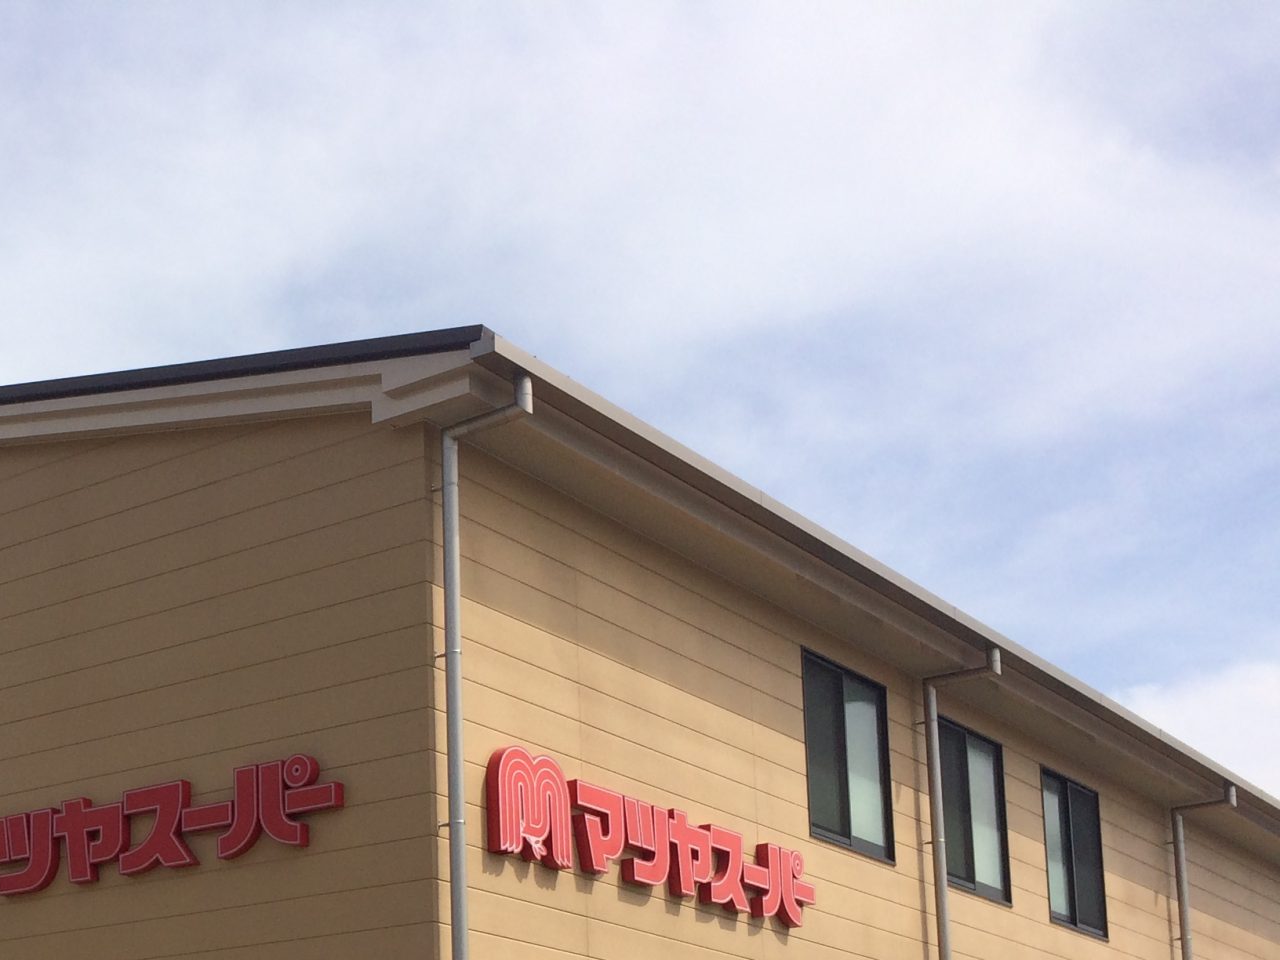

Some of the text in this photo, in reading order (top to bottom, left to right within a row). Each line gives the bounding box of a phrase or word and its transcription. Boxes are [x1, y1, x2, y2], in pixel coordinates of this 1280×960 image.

[567, 779, 815, 928] マツヤスーパー
